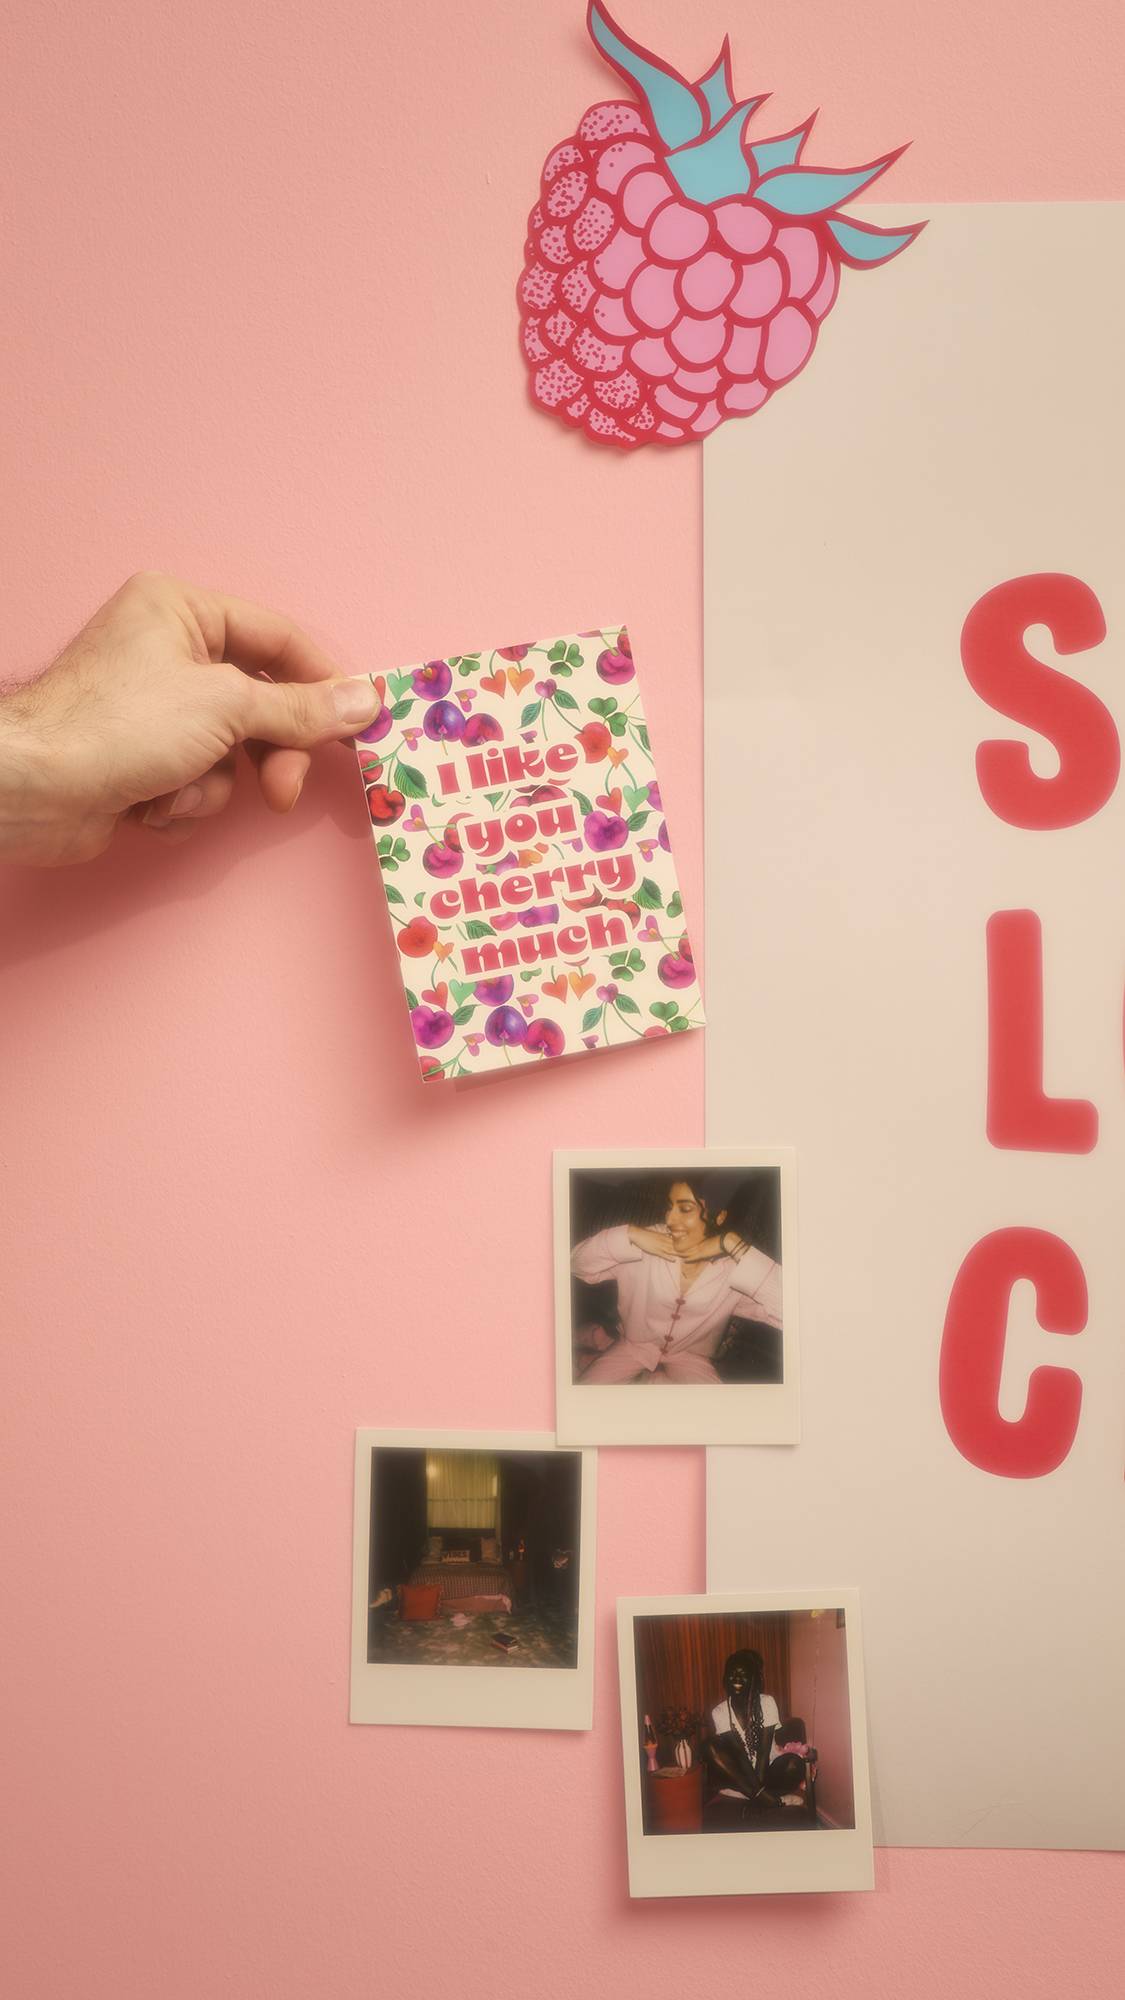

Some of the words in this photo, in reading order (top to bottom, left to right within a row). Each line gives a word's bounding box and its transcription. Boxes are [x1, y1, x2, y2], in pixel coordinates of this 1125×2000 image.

[436, 761, 462, 796] I
[465, 743, 579, 790] like
[463, 804, 578, 858] you
[429, 853, 637, 920] cherry
[460, 913, 629, 976] much
[986, 908, 1125, 1153] L
[938, 1226, 1125, 1483] C
